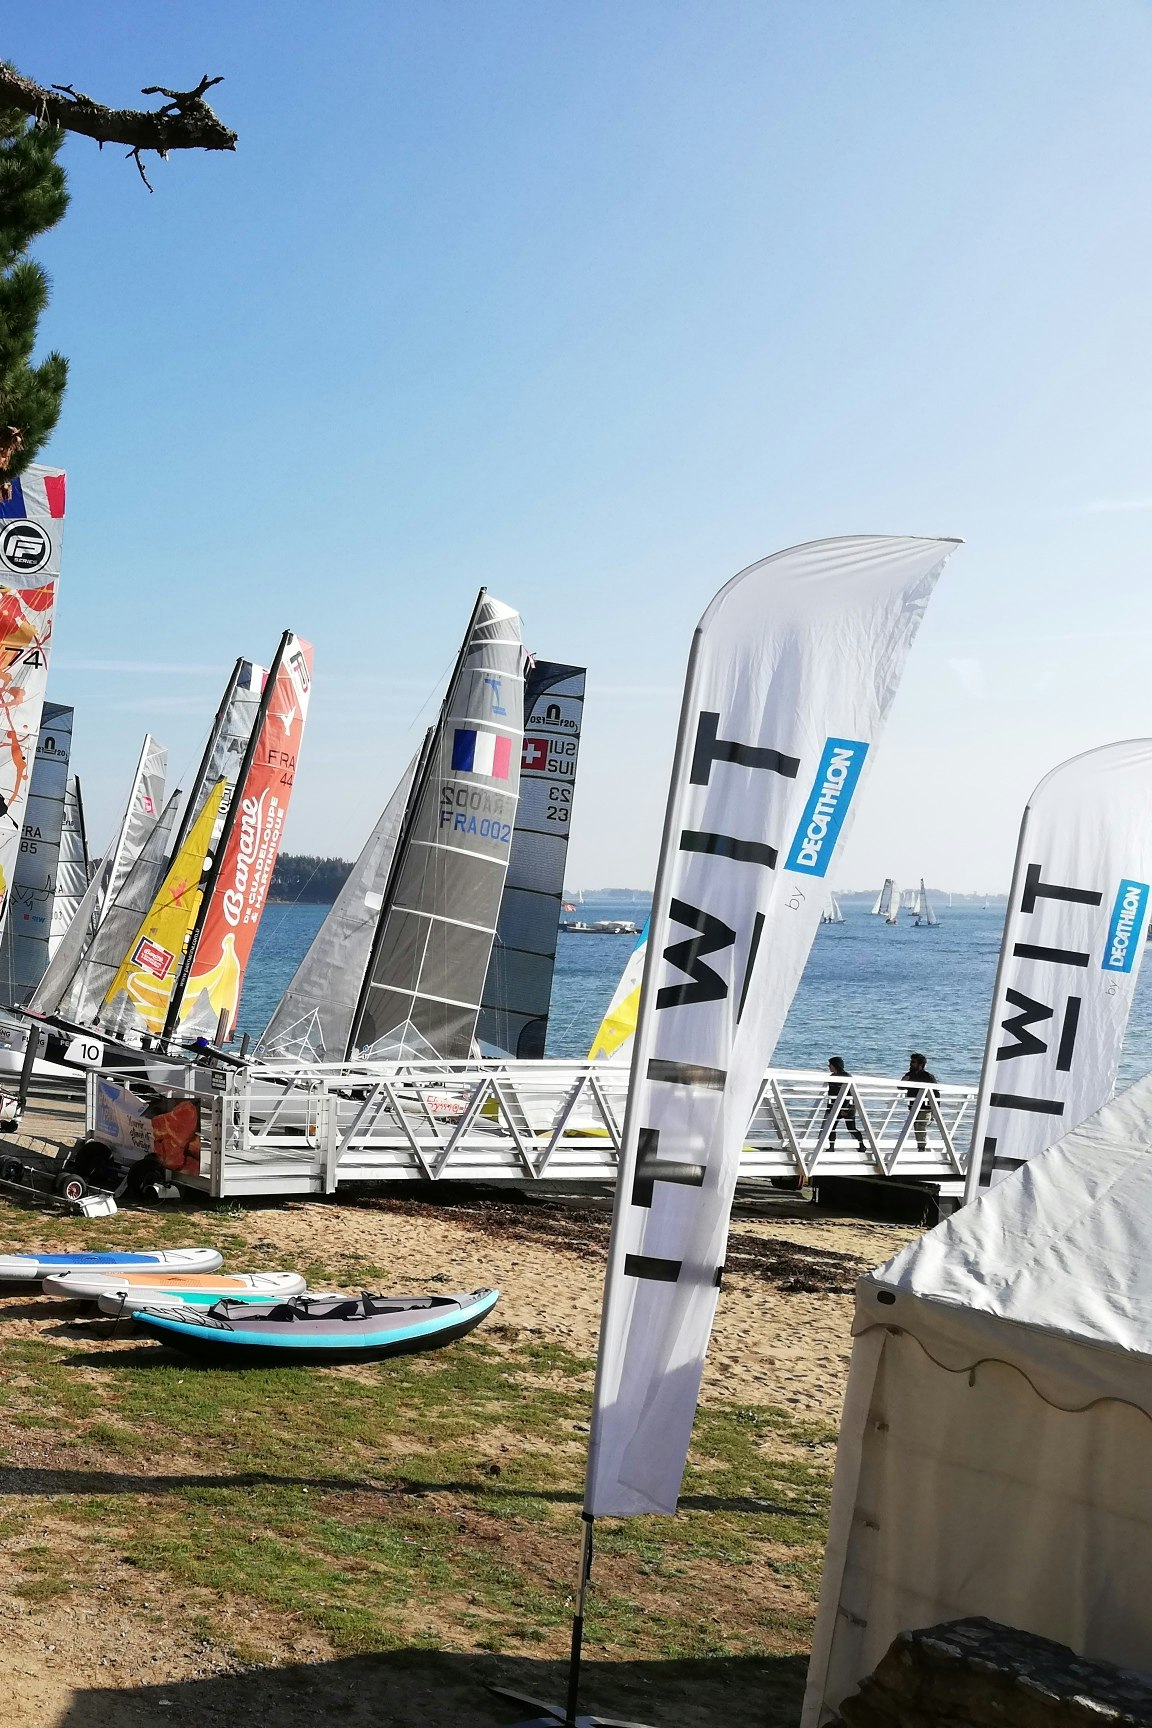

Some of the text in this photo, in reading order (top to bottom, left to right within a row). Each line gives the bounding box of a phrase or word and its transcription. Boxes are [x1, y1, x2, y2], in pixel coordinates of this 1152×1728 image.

[14, 557, 38, 565] SERIES
[5, 647, 43, 669] 74
[268, 750, 295, 772] FRA
[548, 760, 574, 776] SUI
[280, 772, 294, 788] 44
[547, 806, 568, 822] 23
[439, 810, 511, 843] FRA002
[785, 748, 854, 911] by DECATHLON
[21, 842, 37, 854] 85
[224, 790, 266, 926] Banane
[244, 796, 278, 924] DE GUADELOUPE
[251, 808, 284, 923] & MARTINIQUE
[1105, 886, 1142, 996] by DECATHLON
[80, 1043, 99, 1061] 10
